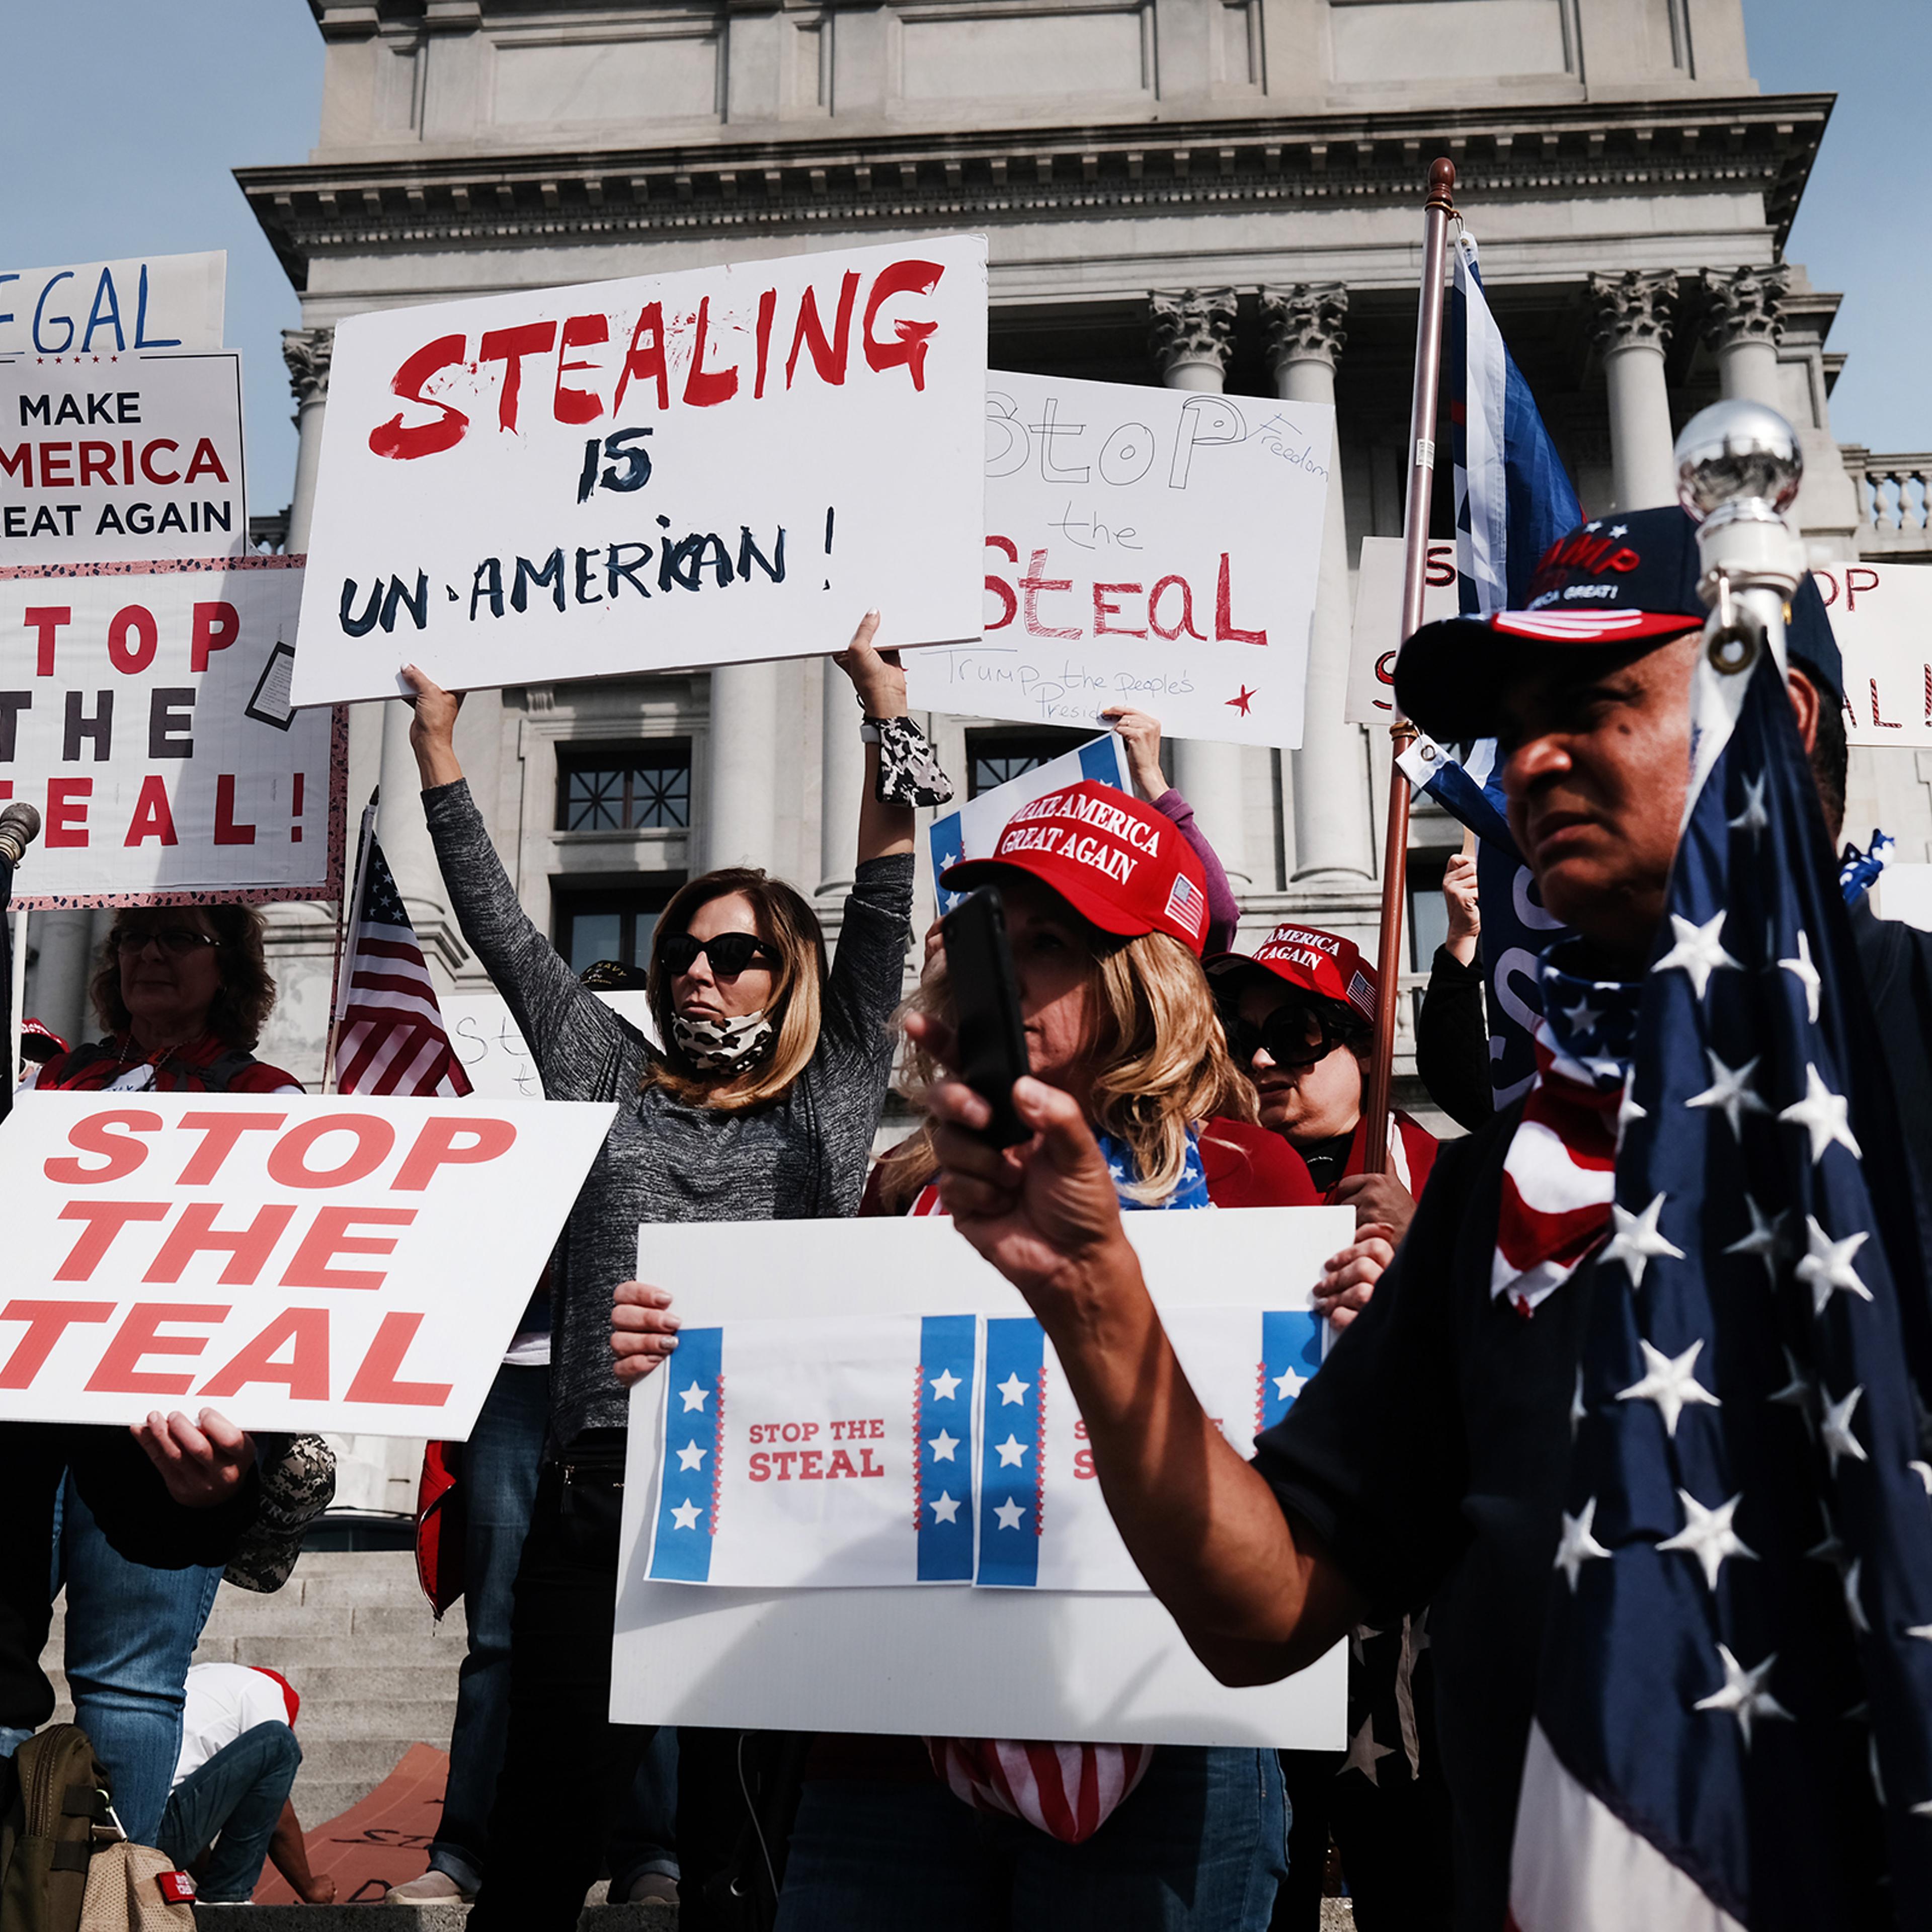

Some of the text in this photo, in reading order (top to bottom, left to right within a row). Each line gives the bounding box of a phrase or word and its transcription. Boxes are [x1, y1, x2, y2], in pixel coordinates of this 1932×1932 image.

[369, 260, 945, 460] STEALING
[20, 392, 141, 426] MAKE
[577, 427, 653, 504] IS
[0, 501, 231, 537] EAT AGAIN
[1048, 501, 1143, 549] the
[24, 602, 239, 676] TOP
[1060, 660, 1107, 690] the
[0, 688, 196, 762] THE
[1008, 793, 1160, 858] MAKE AMERICA
[1001, 826, 1138, 886] GREAT AGAIN
[1263, 928, 1340, 956] AMERICA
[1263, 946, 1323, 971] AGAIN
[43, 1109, 518, 1192] STOP
[53, 1200, 419, 1290] THE
[749, 1419, 884, 1444] STOP THE
[749, 1448, 884, 1482] STEAL
